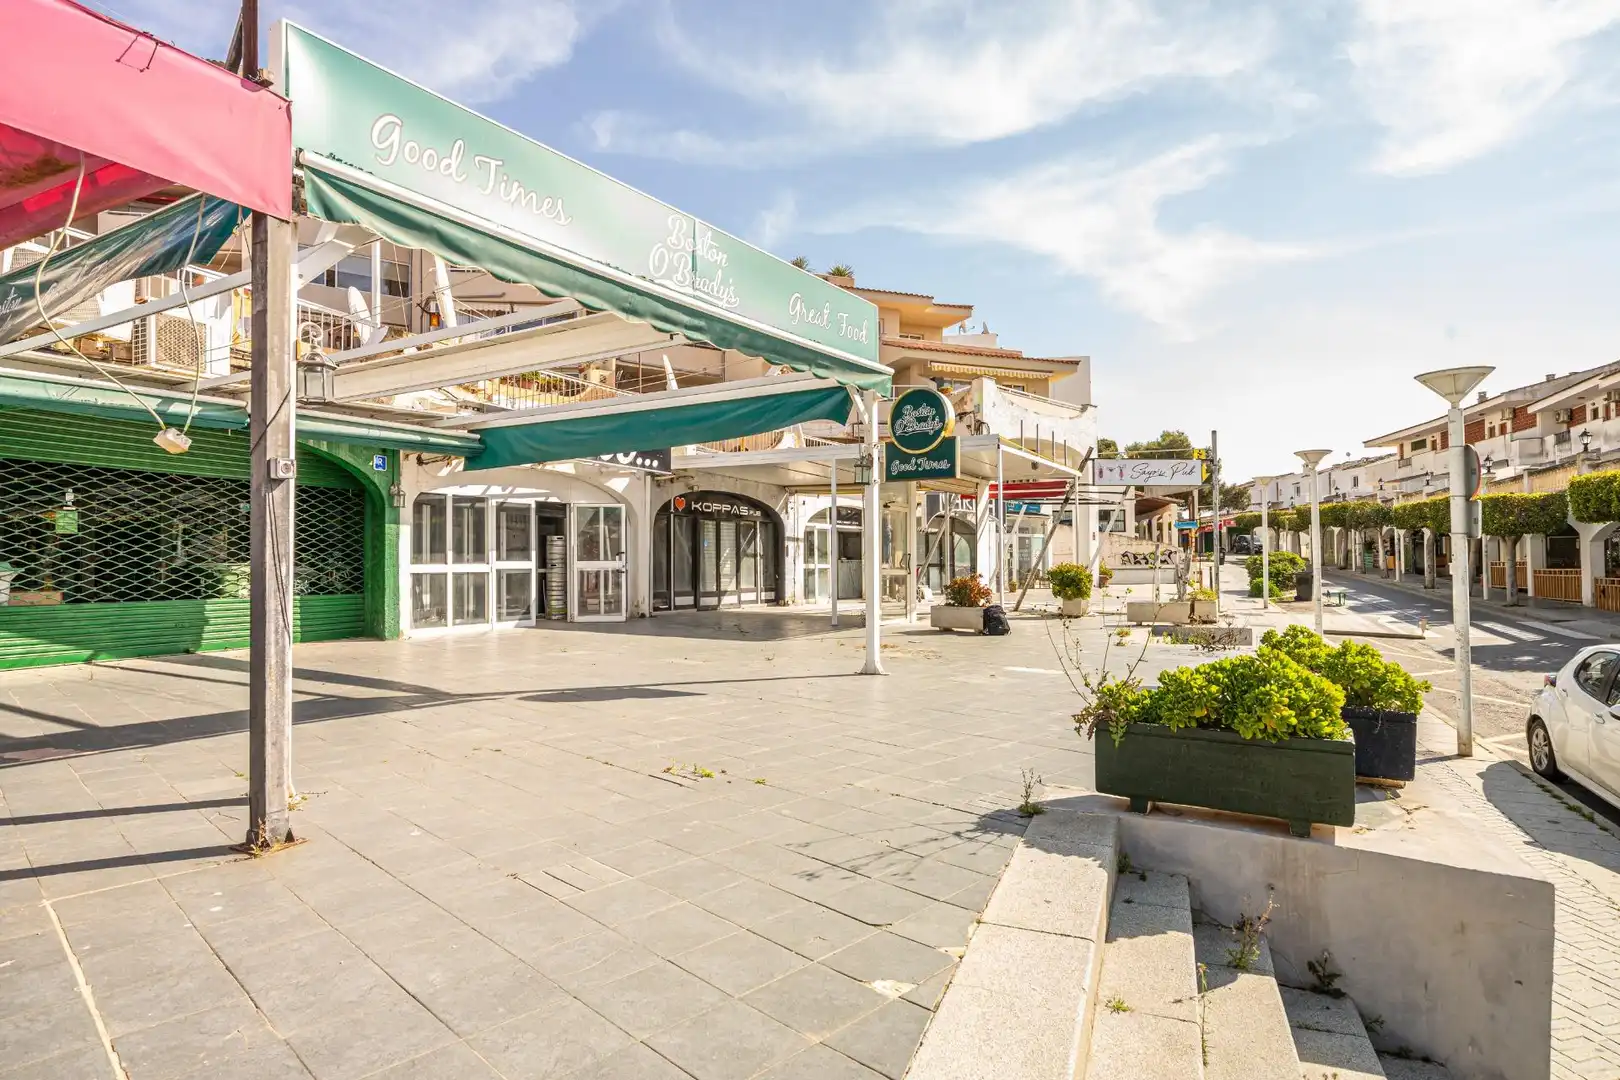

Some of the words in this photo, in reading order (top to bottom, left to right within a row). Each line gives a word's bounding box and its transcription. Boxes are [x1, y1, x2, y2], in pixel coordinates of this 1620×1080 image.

[371, 113, 467, 182] Good
[475, 155, 572, 226] Times
[667, 214, 729, 267] Boston
[649, 242, 740, 308] O'Brady's
[789, 292, 832, 330] Great
[837, 312, 869, 345] Food
[902, 403, 936, 417] Boston
[894, 416, 943, 436] O'Brady's
[891, 457, 917, 475] Good
[917, 456, 951, 472] Times
[1170, 461, 1197, 480] Pub
[691, 501, 748, 516] KOPPAS
